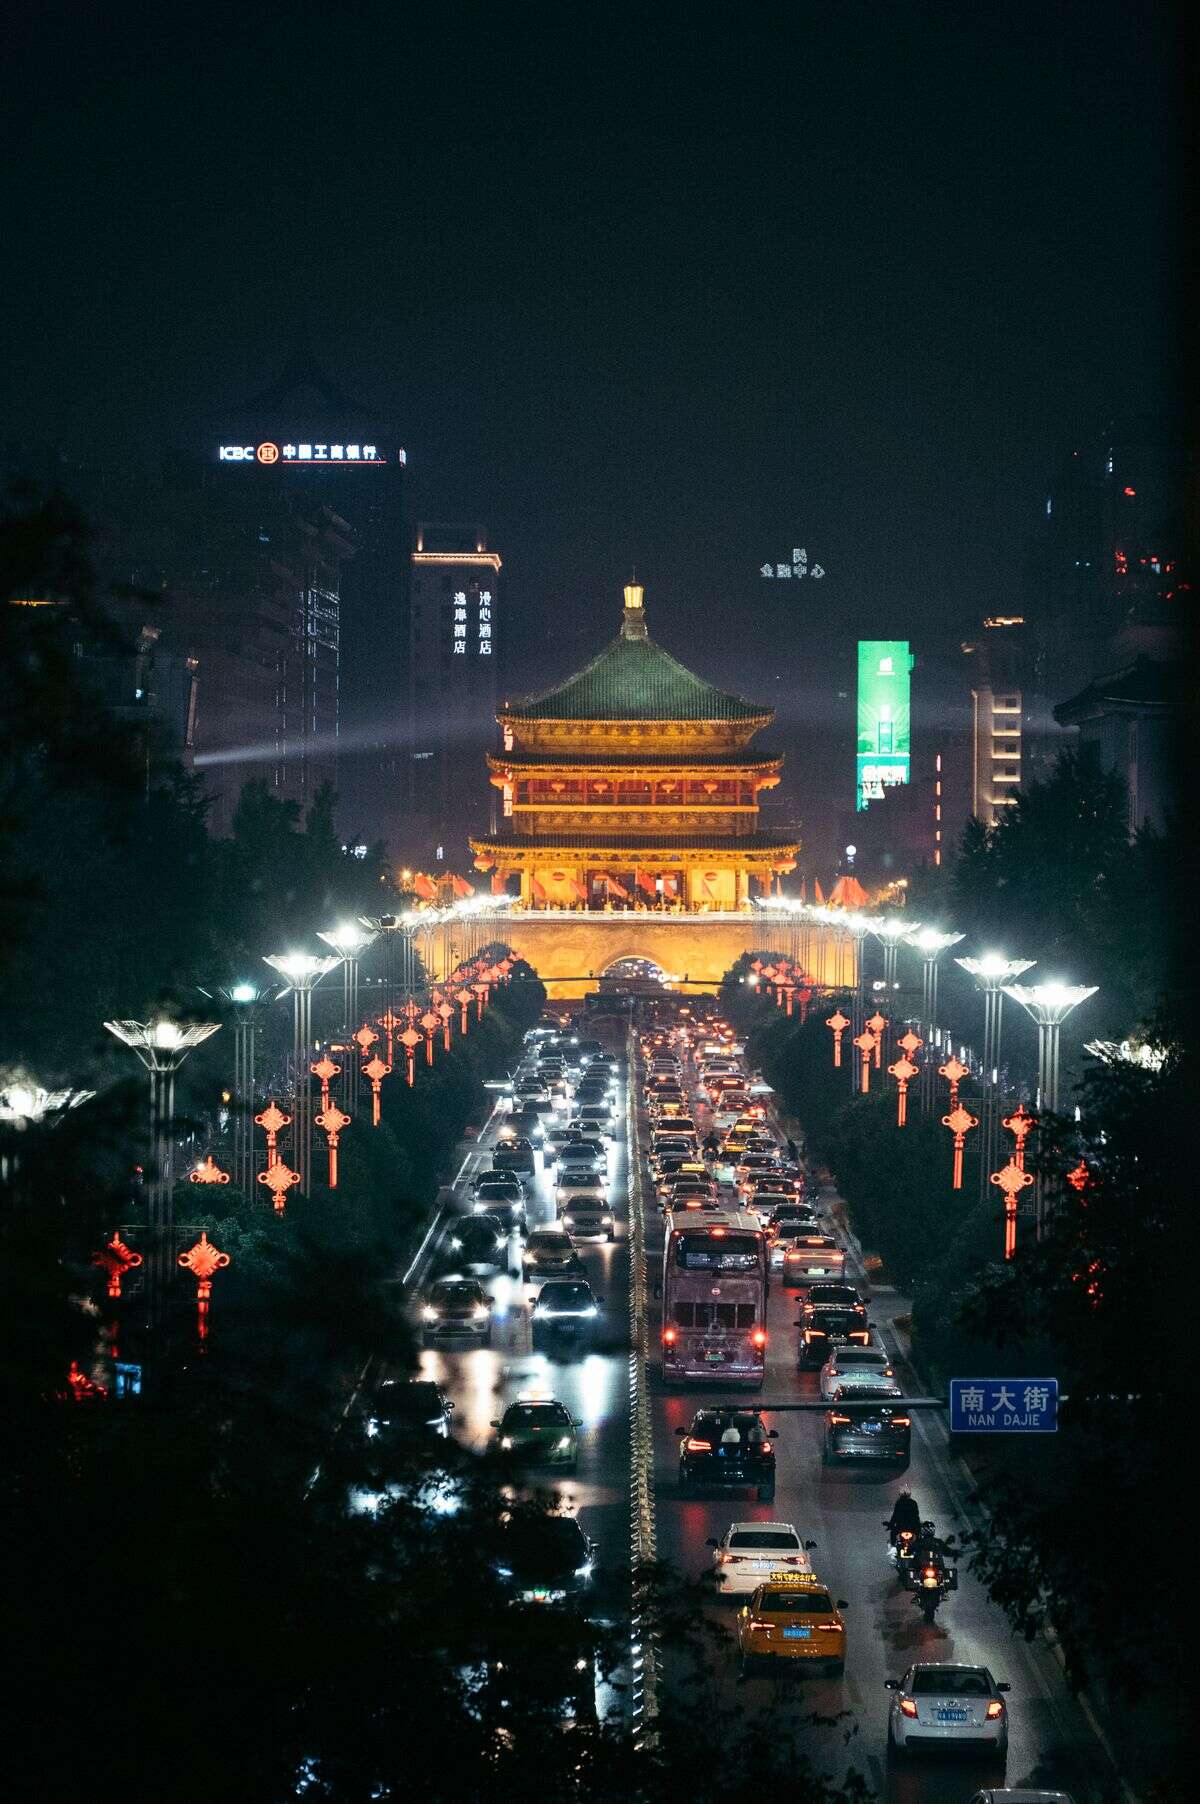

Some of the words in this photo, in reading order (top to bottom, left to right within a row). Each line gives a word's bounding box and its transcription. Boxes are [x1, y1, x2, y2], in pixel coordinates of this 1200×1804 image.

[219, 446, 255, 460] ICBC
[282, 443, 377, 460] 中国工商银行
[479, 591, 492, 655] 漫心酒店
[960, 1386, 1049, 1412] 南大街
[968, 1413, 995, 1426] NAN
[1003, 1413, 1040, 1427] DAJIE
